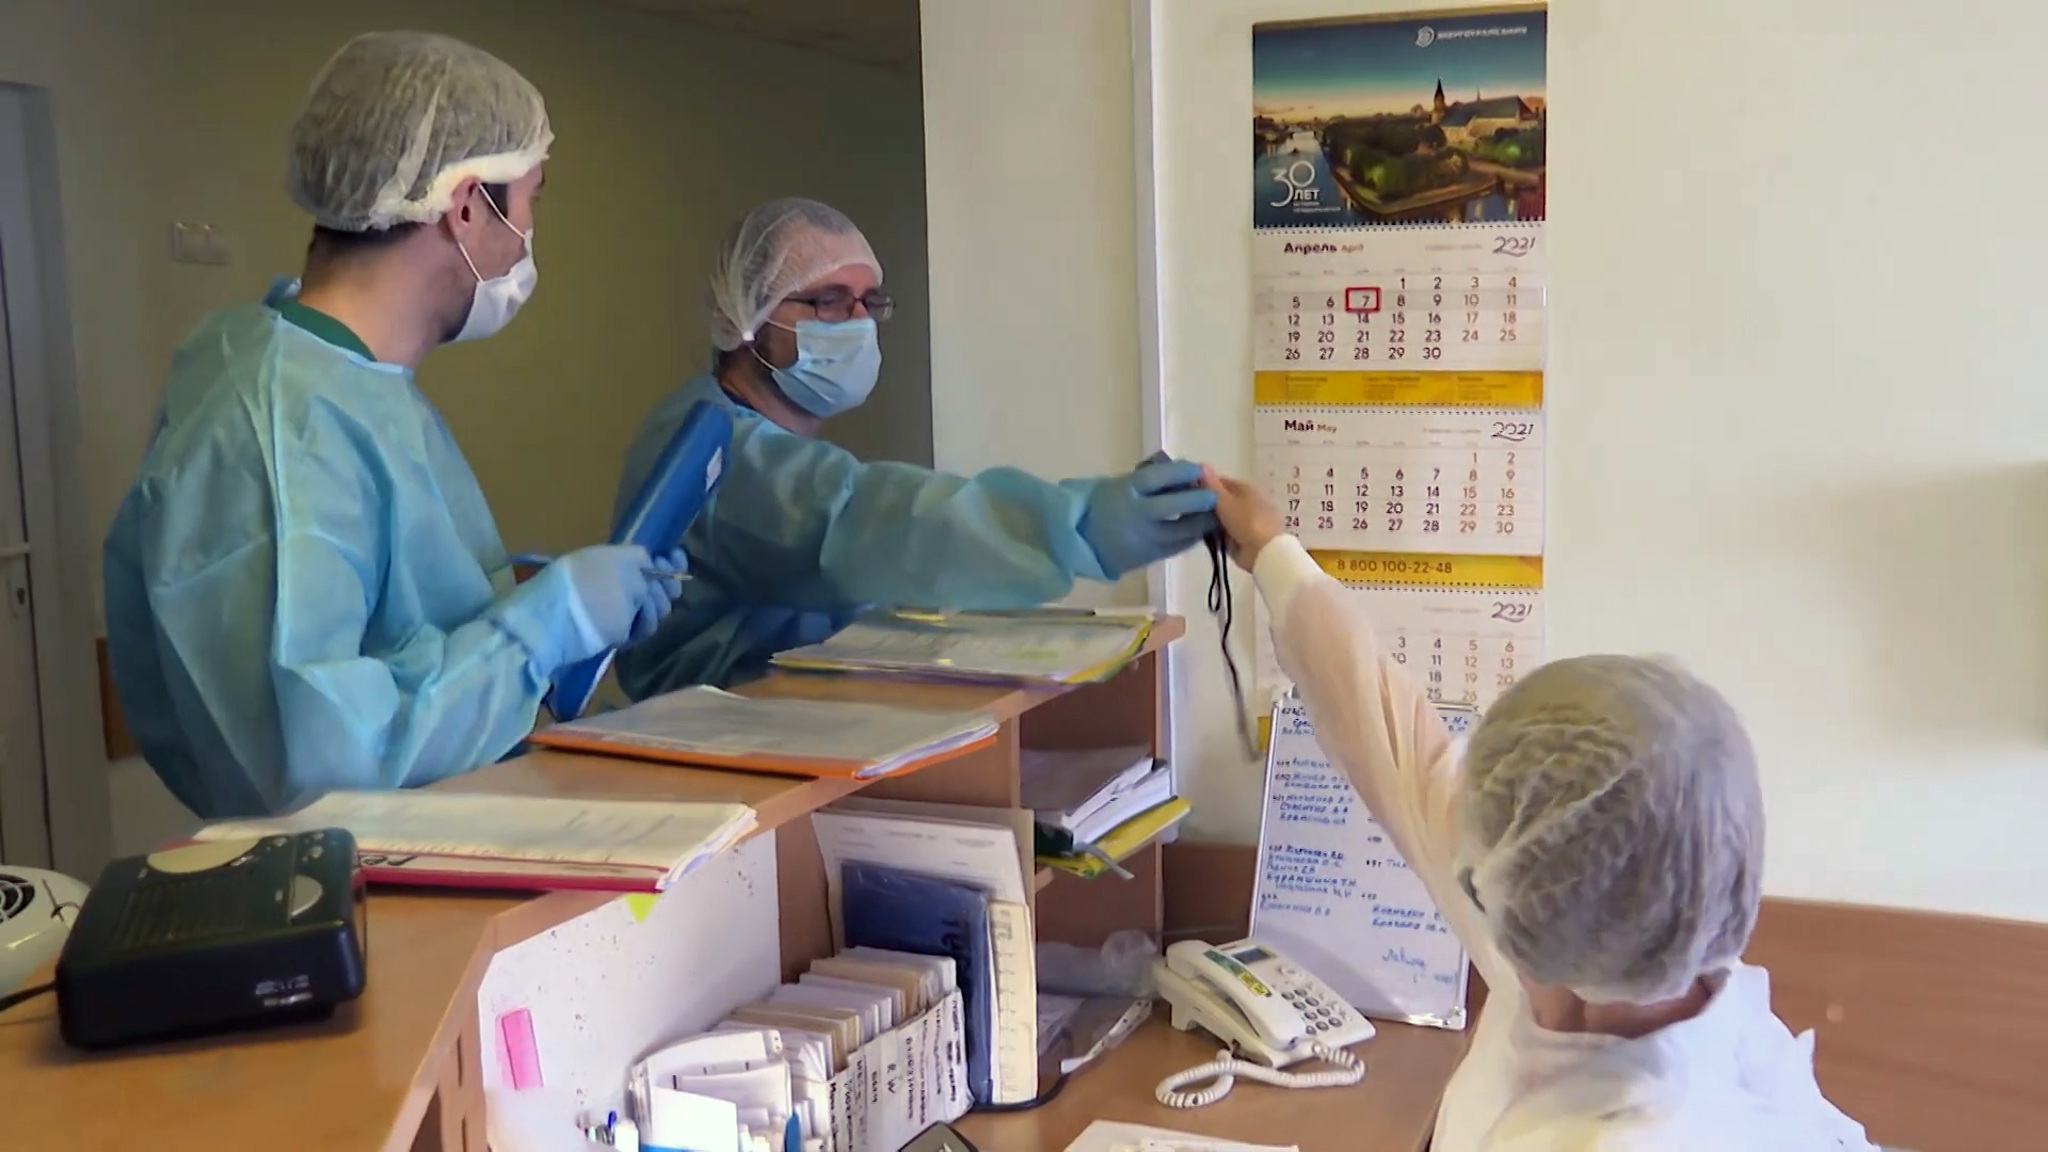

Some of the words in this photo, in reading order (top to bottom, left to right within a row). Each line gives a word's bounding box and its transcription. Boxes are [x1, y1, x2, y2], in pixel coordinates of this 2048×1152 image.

[1270, 160, 1315, 207] 30
[1294, 189, 1320, 200] ЛЕТ
[1284, 242, 1337, 255] Апрель
[1400, 278, 1406, 290] 1
[1434, 276, 1442, 290] 2
[1471, 276, 1479, 288] 3
[1508, 276, 1516, 288] 4
[1292, 297, 1300, 308] 5
[1326, 296, 1334, 308] 6
[1362, 296, 1370, 308] 7
[1396, 295, 1405, 307] 8
[1434, 294, 1442, 306] 9
[1464, 294, 1479, 306] 10
[1506, 294, 1516, 306] 11
[1288, 314, 1300, 326] 12
[1322, 314, 1334, 326] 13
[1358, 314, 1370, 324] 14
[1392, 312, 1405, 324] 15
[1428, 312, 1442, 324] 16
[1466, 312, 1478, 324] 17
[1503, 312, 1516, 324] 18
[1288, 331, 1300, 343] 19
[1318, 330, 1335, 343] 20
[1357, 330, 1370, 342] 21
[1389, 330, 1405, 342] 22
[1424, 330, 1442, 342] 23
[1462, 330, 1479, 342] 24
[1500, 330, 1516, 342] 25
[1284, 348, 1300, 360] 26
[1319, 348, 1334, 360] 27
[1354, 348, 1370, 360] 28
[1388, 347, 1405, 360] 29
[1422, 347, 1442, 359] 30
[1284, 420, 1314, 432] Май
[1472, 452, 1477, 464] 1
[1507, 452, 1515, 464] 2
[1326, 467, 1334, 478] 4
[1360, 467, 1369, 480] 5
[1395, 468, 1404, 480] 6
[1432, 468, 1440, 480] 7
[1468, 469, 1477, 482] 8
[1506, 470, 1515, 482] 9
[1286, 483, 1300, 495] 10
[1324, 484, 1334, 496] 11
[1356, 485, 1369, 497] 12
[1390, 485, 1404, 497] 13
[1426, 486, 1440, 498] 14
[1463, 486, 1477, 498] 15
[1501, 486, 1515, 499] 16
[1288, 500, 1300, 512] 17
[1321, 500, 1334, 512] 18
[1356, 502, 1368, 514] 19
[1386, 502, 1404, 514] 20
[1426, 502, 1440, 514] 21
[1460, 504, 1477, 516] 22
[1497, 504, 1515, 516] 23
[1284, 516, 1300, 528] 24
[1318, 517, 1334, 529] 25
[1352, 518, 1368, 530] 26
[1388, 518, 1403, 531] 27
[1423, 520, 1440, 532] 28
[1460, 520, 1476, 533] 29
[1496, 521, 1514, 533] 30
[1337, 559, 1345, 571] 8
[1350, 560, 1377, 572] 800
[1382, 560, 1452, 574] 100-22-48
[1398, 636, 1406, 648] 3
[1434, 638, 1442, 649] 4
[1469, 639, 1478, 651] 5
[1506, 641, 1514, 652] 6
[1432, 654, 1442, 666] 11
[1464, 656, 1477, 668] 12
[1500, 658, 1514, 670] 13
[1429, 671, 1442, 682] 18
[1465, 672, 1477, 684] 19
